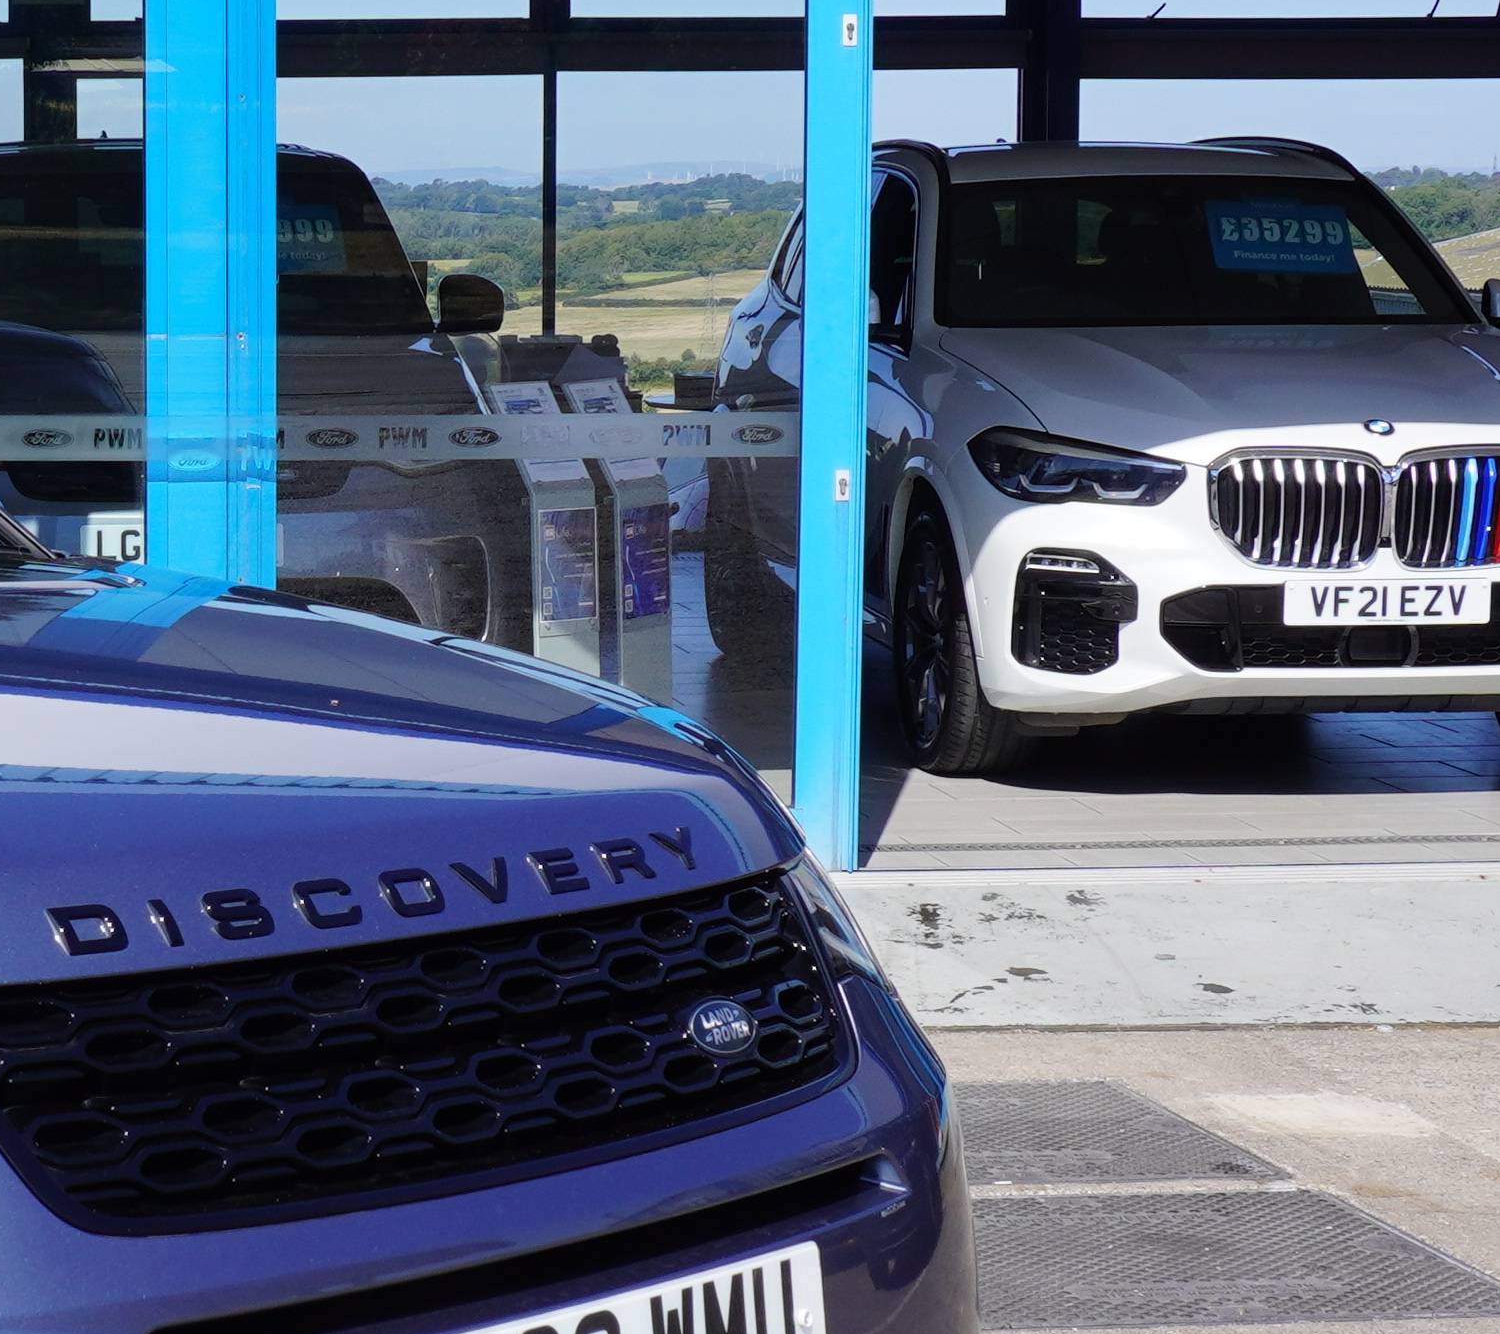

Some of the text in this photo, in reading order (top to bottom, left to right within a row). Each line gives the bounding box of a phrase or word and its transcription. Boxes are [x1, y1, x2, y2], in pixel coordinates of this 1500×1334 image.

[1221, 217, 1344, 245] £35299
[1233, 250, 1336, 263] Finance me today!
[28, 430, 70, 447] Ford
[93, 428, 142, 449] PWM
[378, 427, 427, 449] PWM
[1311, 585, 1467, 617] VF21 EZV
[45, 826, 697, 956] DISCOVERY
[699, 1007, 735, 1030] LAND
[712, 1020, 752, 1046] ROVER
